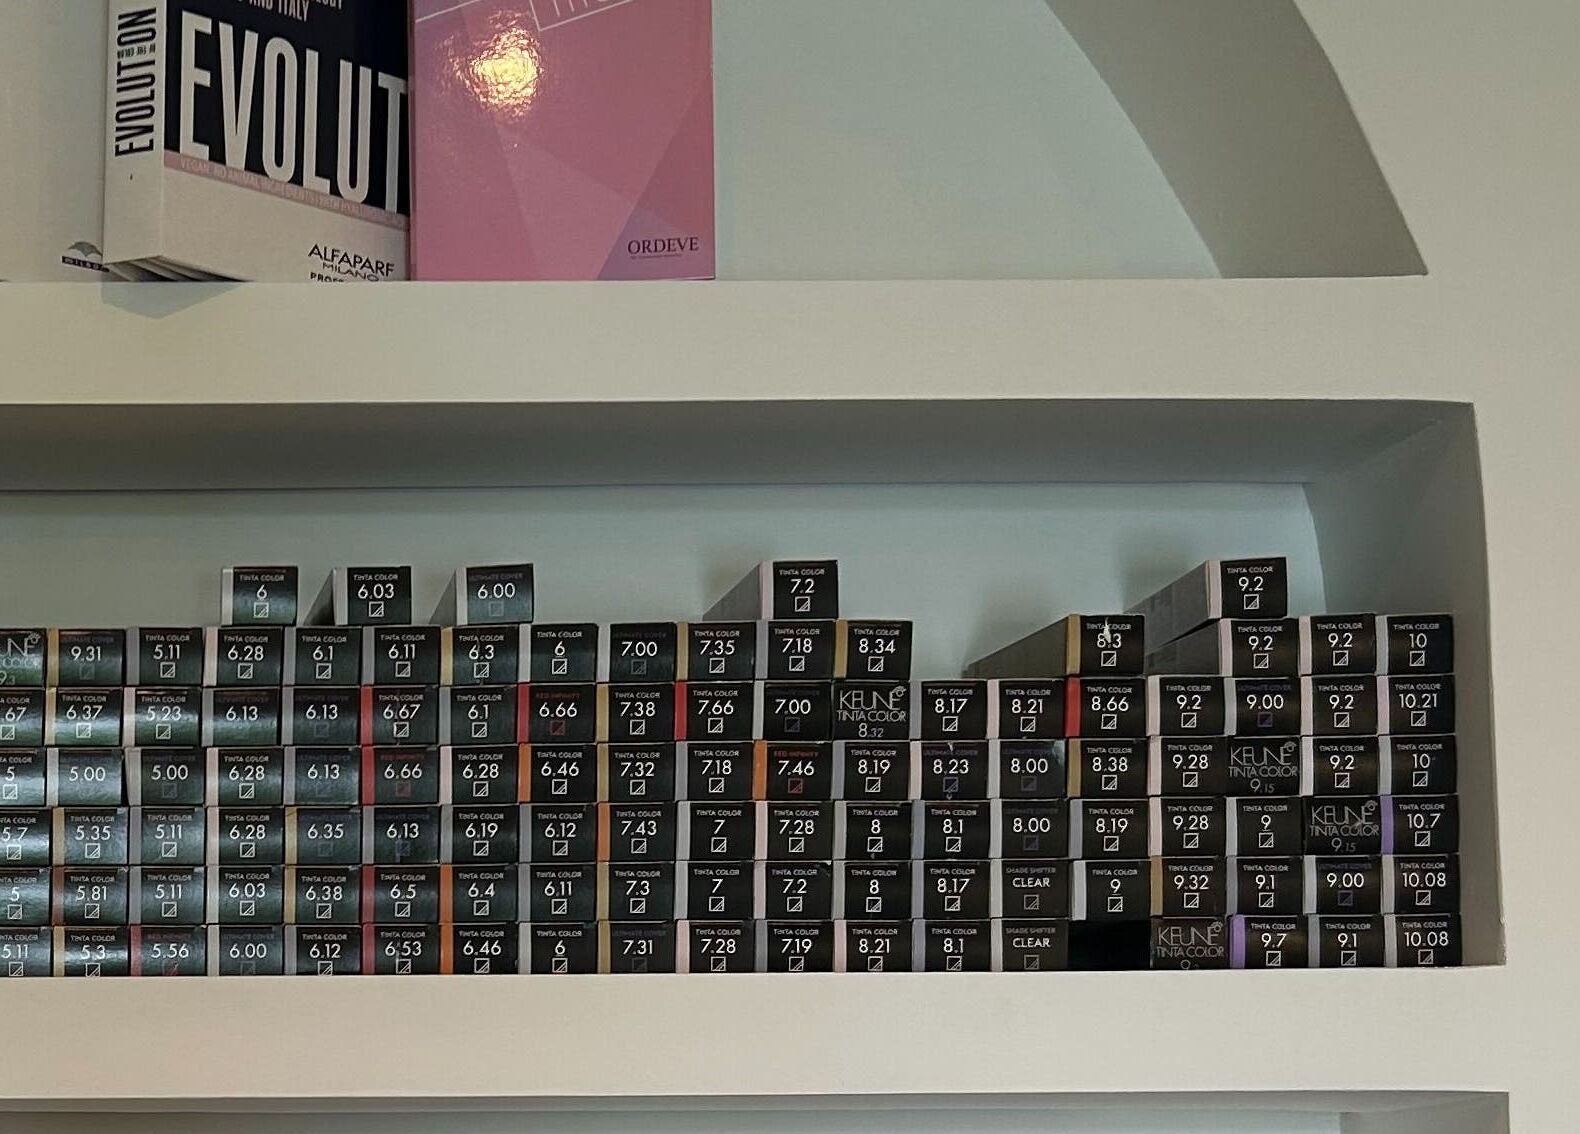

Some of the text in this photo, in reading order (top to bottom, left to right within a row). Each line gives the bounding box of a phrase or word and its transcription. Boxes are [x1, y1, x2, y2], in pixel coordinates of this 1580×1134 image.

[628, 237, 699, 254] ORDEVE
[308, 244, 395, 277] ALFAPARF
[323, 262, 379, 282] MILANO
[358, 584, 395, 599] 6.03
[790, 578, 815, 594] 7.2
[1238, 576, 1264, 592] 9.2
[71, 646, 102, 662] 9.31
[388, 644, 416, 660] 6.11
[859, 639, 895, 654] 8.34
[697, 700, 733, 716] 7.66
[1399, 693, 1438, 709] 10.21
[539, 702, 578, 718] 6.66
[836, 710, 907, 722] TINTA COLOR
[859, 723, 884, 739] 8.32
[778, 759, 814, 776] 7.46
[1013, 877, 1050, 889] CLEAR
[1174, 874, 1209, 891] 9.32
[77, 885, 108, 901] 5.81
[305, 885, 342, 901] 6.38
[1404, 932, 1448, 948] 10.08
[385, 941, 422, 957] 6.53
